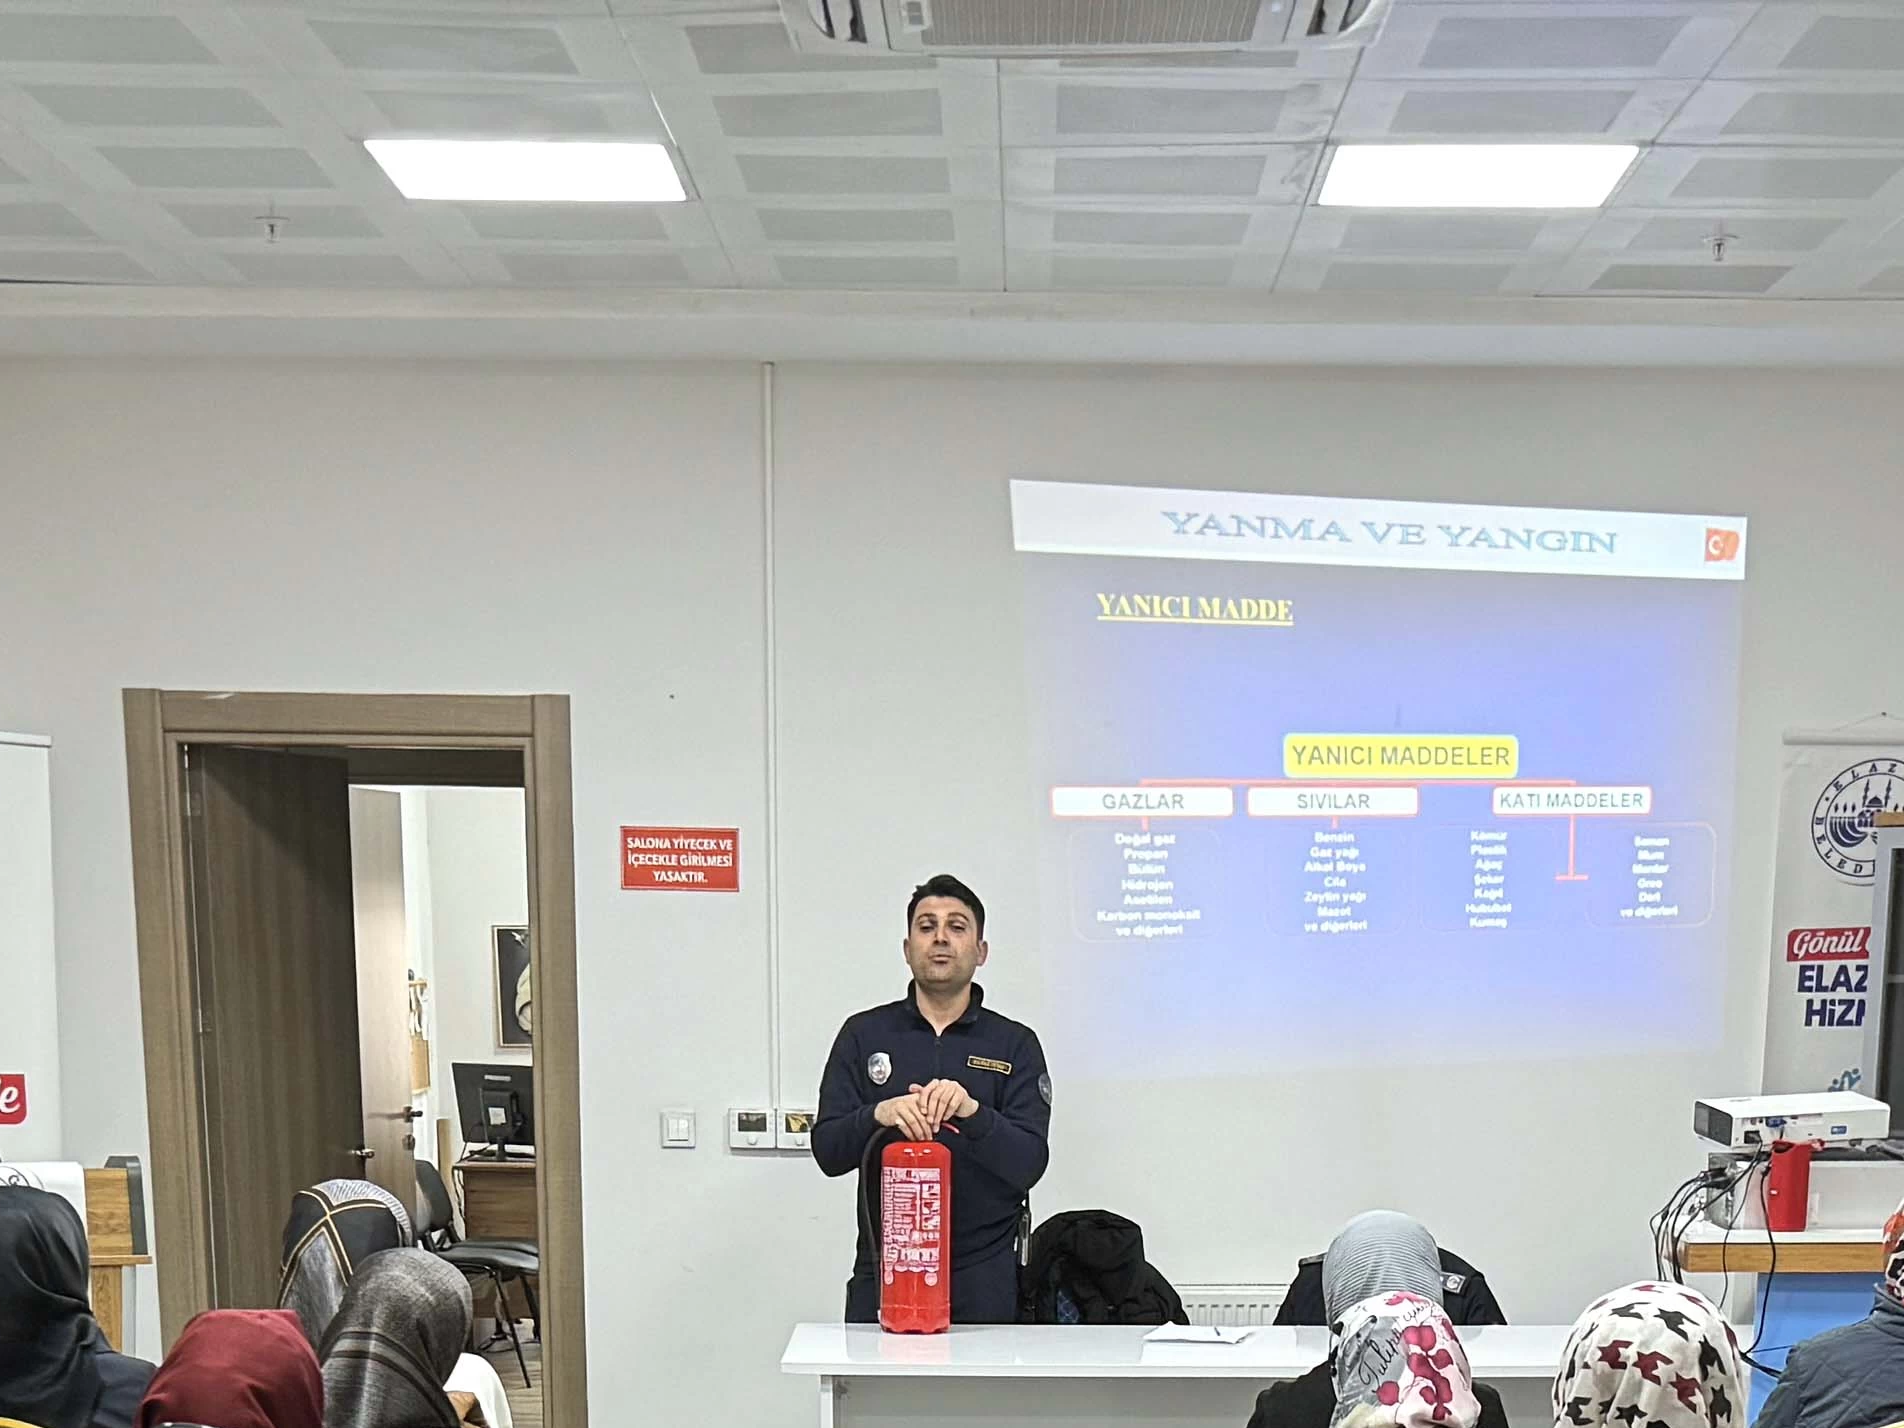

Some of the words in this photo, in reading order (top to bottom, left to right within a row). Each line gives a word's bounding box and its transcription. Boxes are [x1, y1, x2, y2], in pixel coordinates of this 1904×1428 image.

[1160, 511, 1352, 542] YANMA
[1361, 521, 1426, 545] VE
[1437, 525, 1618, 554] YANGIN
[1097, 593, 1192, 619] YANICI
[1198, 597, 1293, 621] MADDE
[1292, 745, 1373, 767] YANICI
[1380, 745, 1510, 767] MADDELER
[1101, 793, 1185, 810] GAZLAR
[1297, 793, 1371, 810] SIVILAR
[1500, 792, 1542, 809] KATI
[1546, 792, 1644, 809] MADDELER
[627, 837, 671, 849] SALONA
[673, 834, 717, 850] YİYECEK
[720, 839, 733, 850] VE
[628, 850, 678, 868] İÇECEKLE
[680, 851, 733, 867] GİRİLMESİ
[1797, 964, 1868, 993] ELAZ
